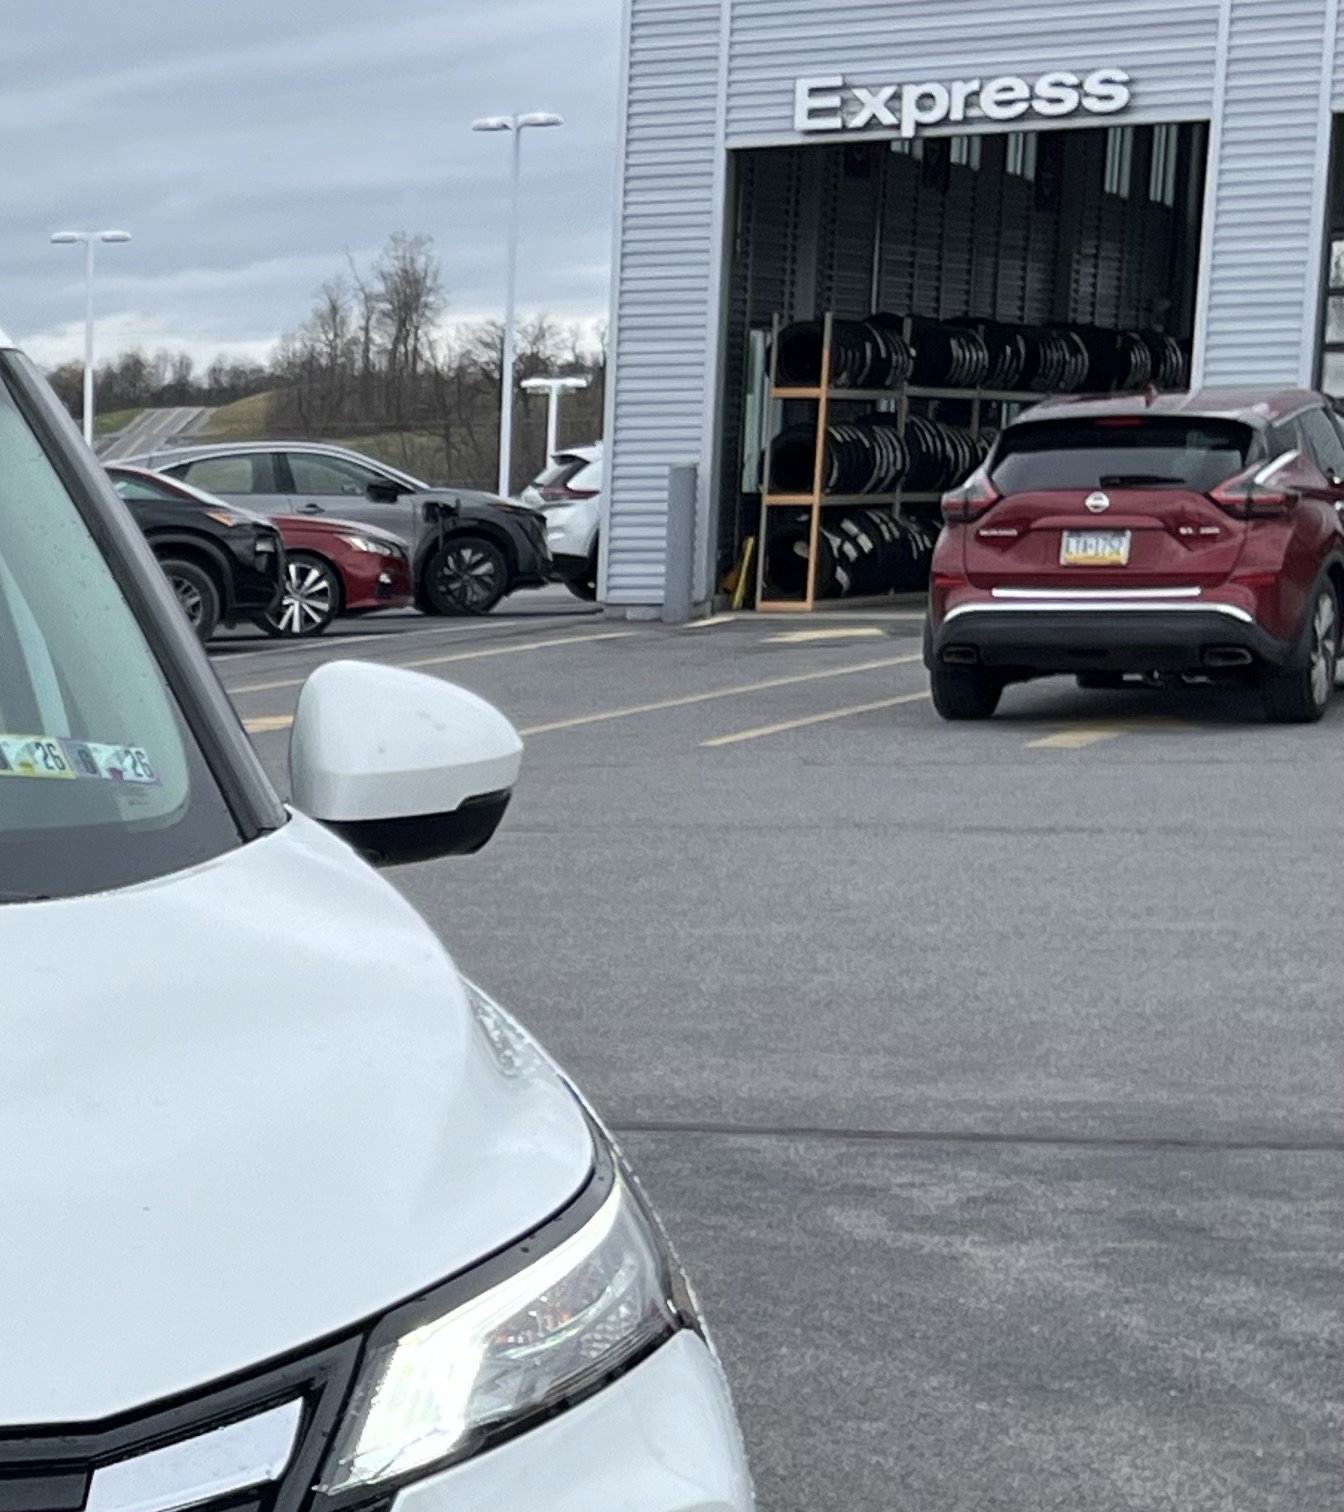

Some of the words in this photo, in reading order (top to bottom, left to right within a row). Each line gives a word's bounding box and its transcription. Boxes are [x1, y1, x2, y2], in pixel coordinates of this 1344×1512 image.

[794, 68, 1131, 138] Express
[34, 742, 66, 770] 26
[124, 750, 155, 778] 26
